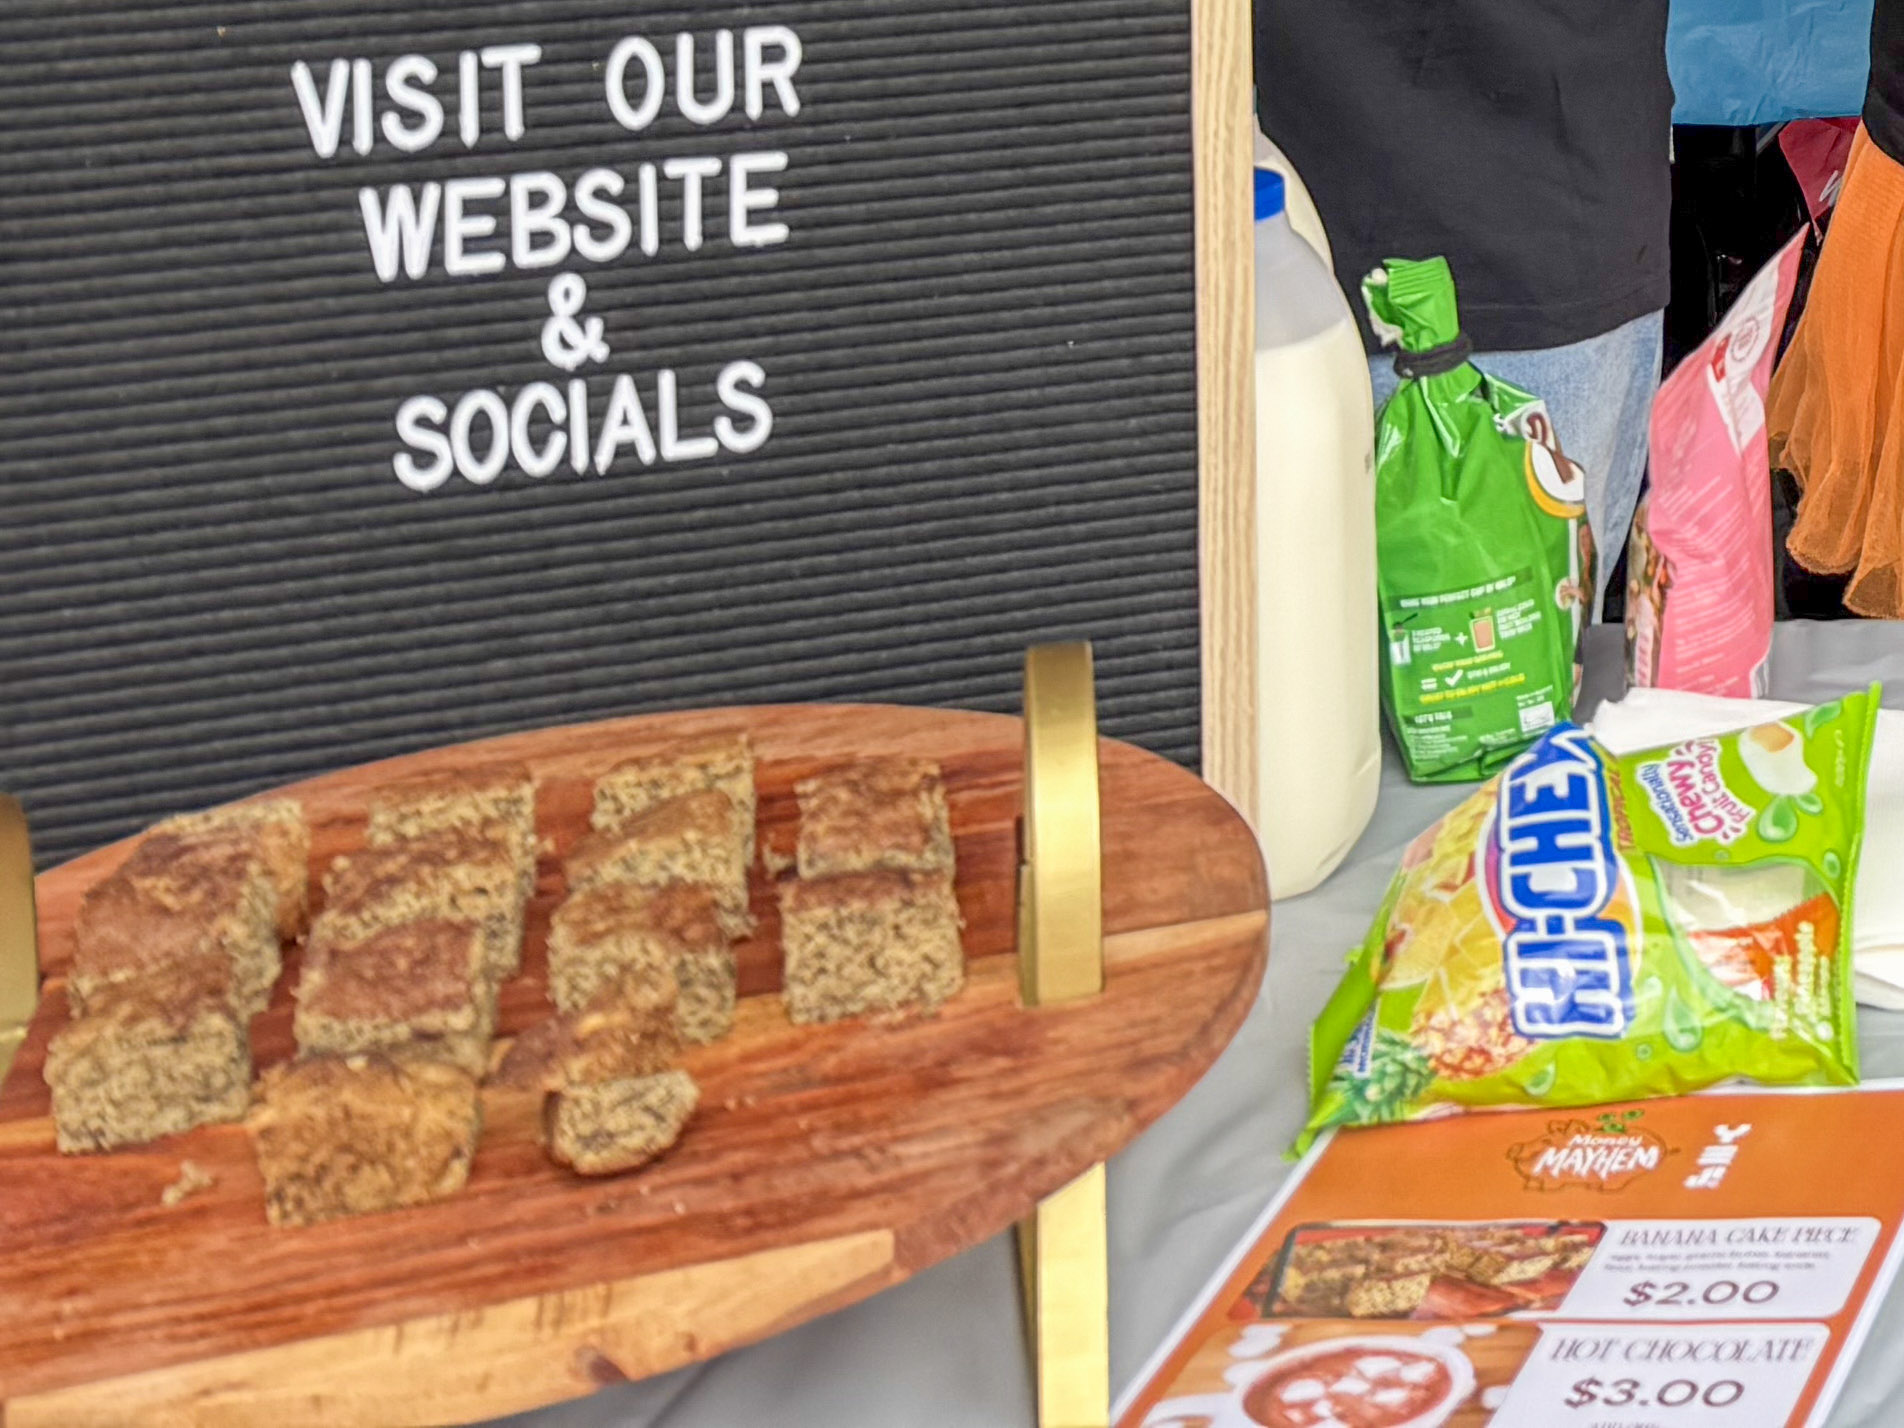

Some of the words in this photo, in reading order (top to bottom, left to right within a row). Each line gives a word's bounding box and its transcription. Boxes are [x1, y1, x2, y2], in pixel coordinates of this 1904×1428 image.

[291, 44, 541, 157] VISIT
[604, 25, 803, 130] OUR
[360, 152, 790, 281] WEBSITE
[541, 273, 609, 368] &
[393, 362, 773, 490] SOCIALS
[1642, 764, 1694, 842] Sensationally
[1667, 758, 1724, 835] Chewy
[1711, 792, 1750, 824] Fruit
[1532, 1145, 1661, 1180] MAYHEM
[1621, 1228, 1718, 1246] BANANA
[1724, 1227, 1785, 1244] CAKE
[1622, 1279, 1780, 1307] $2.00
[1549, 1336, 1615, 1363] HOT
[1622, 1336, 1815, 1363] CHOCOLATE
[1564, 1377, 1745, 1409] $3.00
